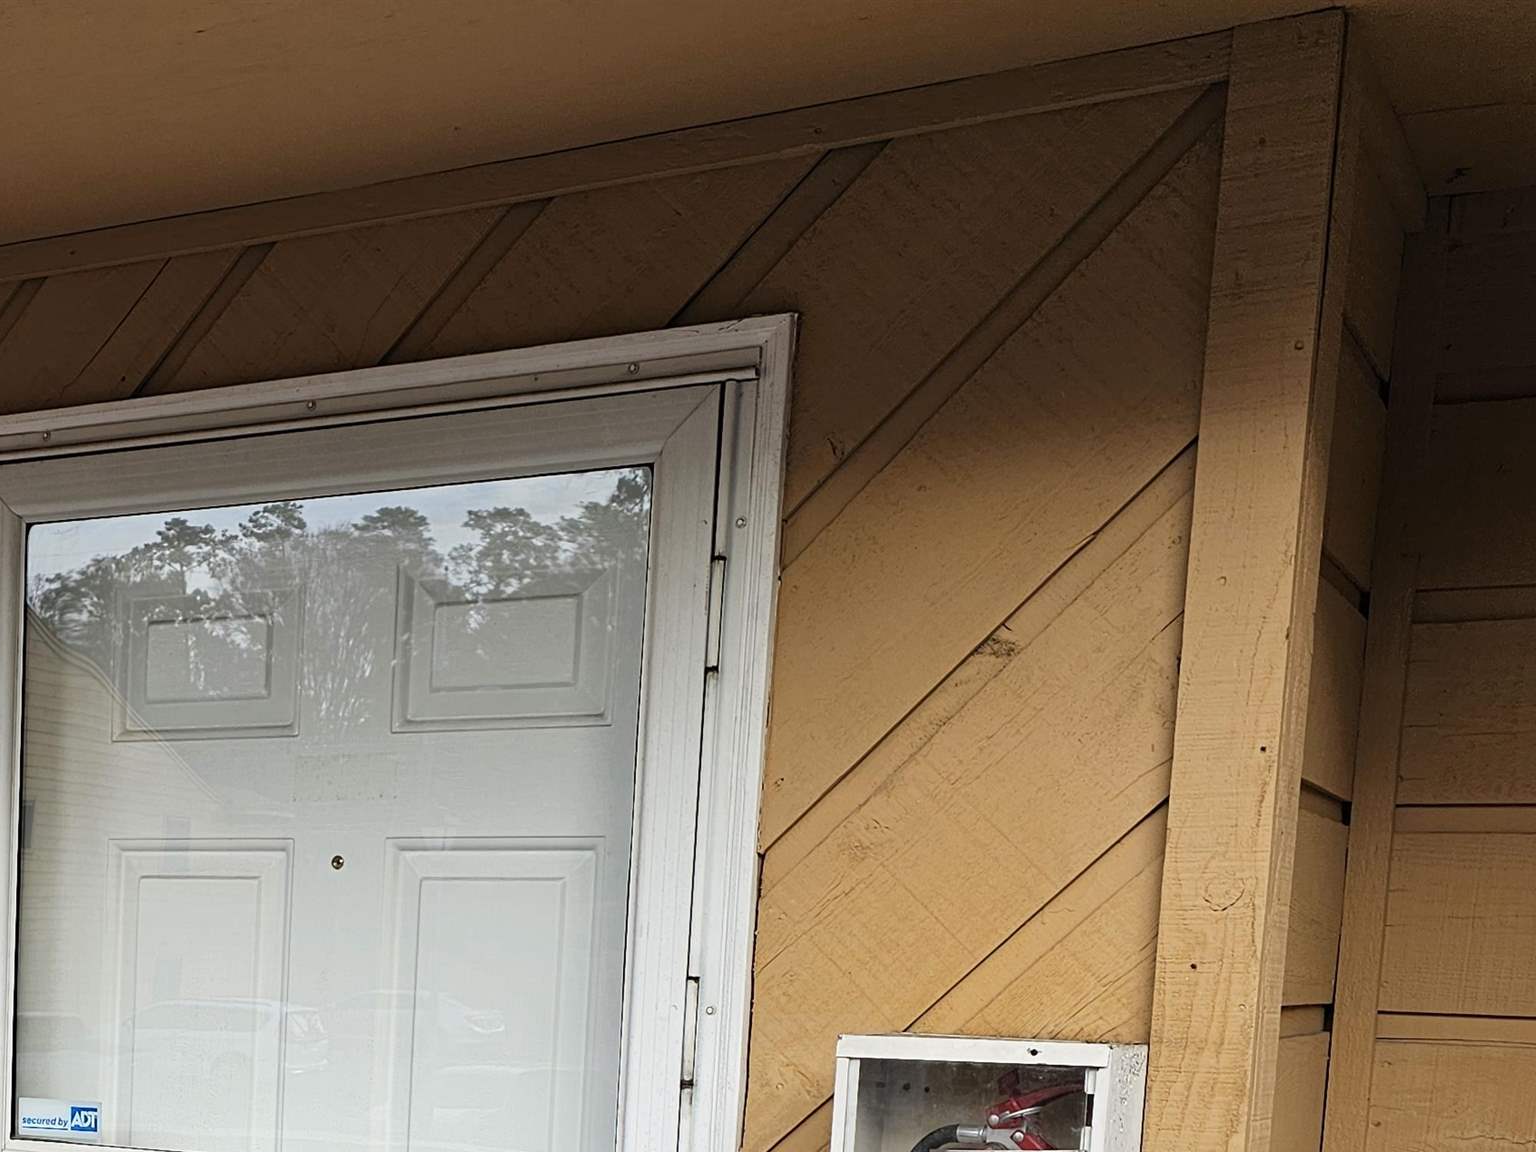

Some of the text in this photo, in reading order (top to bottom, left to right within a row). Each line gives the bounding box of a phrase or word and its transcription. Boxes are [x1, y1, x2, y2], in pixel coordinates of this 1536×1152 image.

[22, 1110, 98, 1129] secured by ADT
